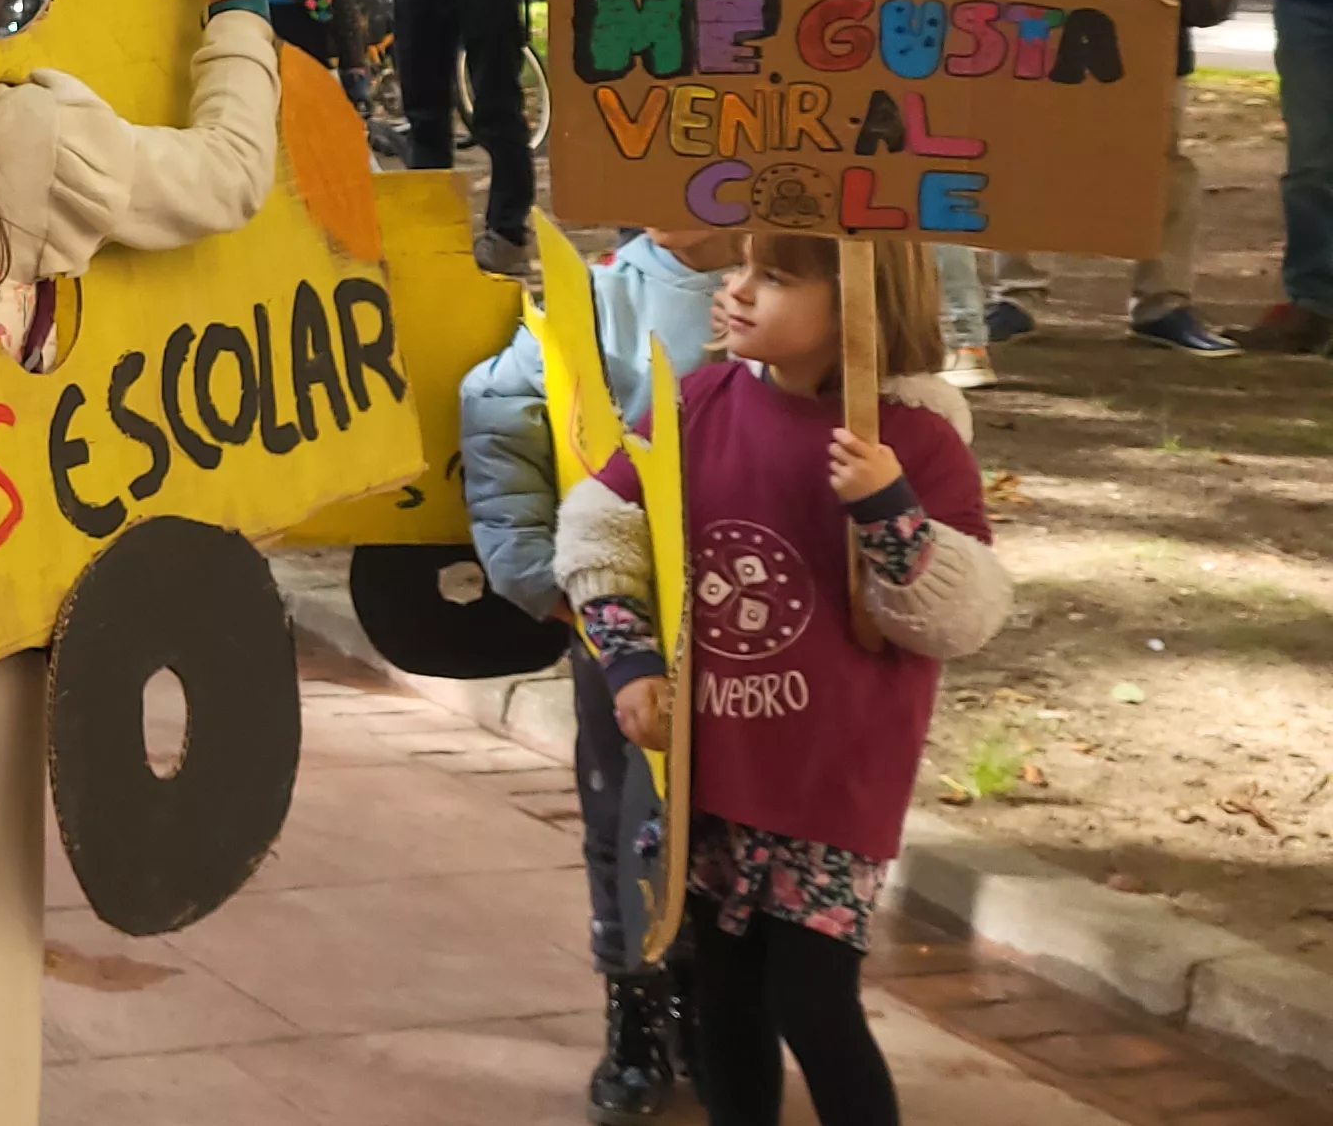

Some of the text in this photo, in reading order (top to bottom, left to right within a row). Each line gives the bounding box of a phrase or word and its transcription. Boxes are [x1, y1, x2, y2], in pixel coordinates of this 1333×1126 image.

[594, 81, 988, 159] VENIR AL
[685, 159, 990, 233] COLE
